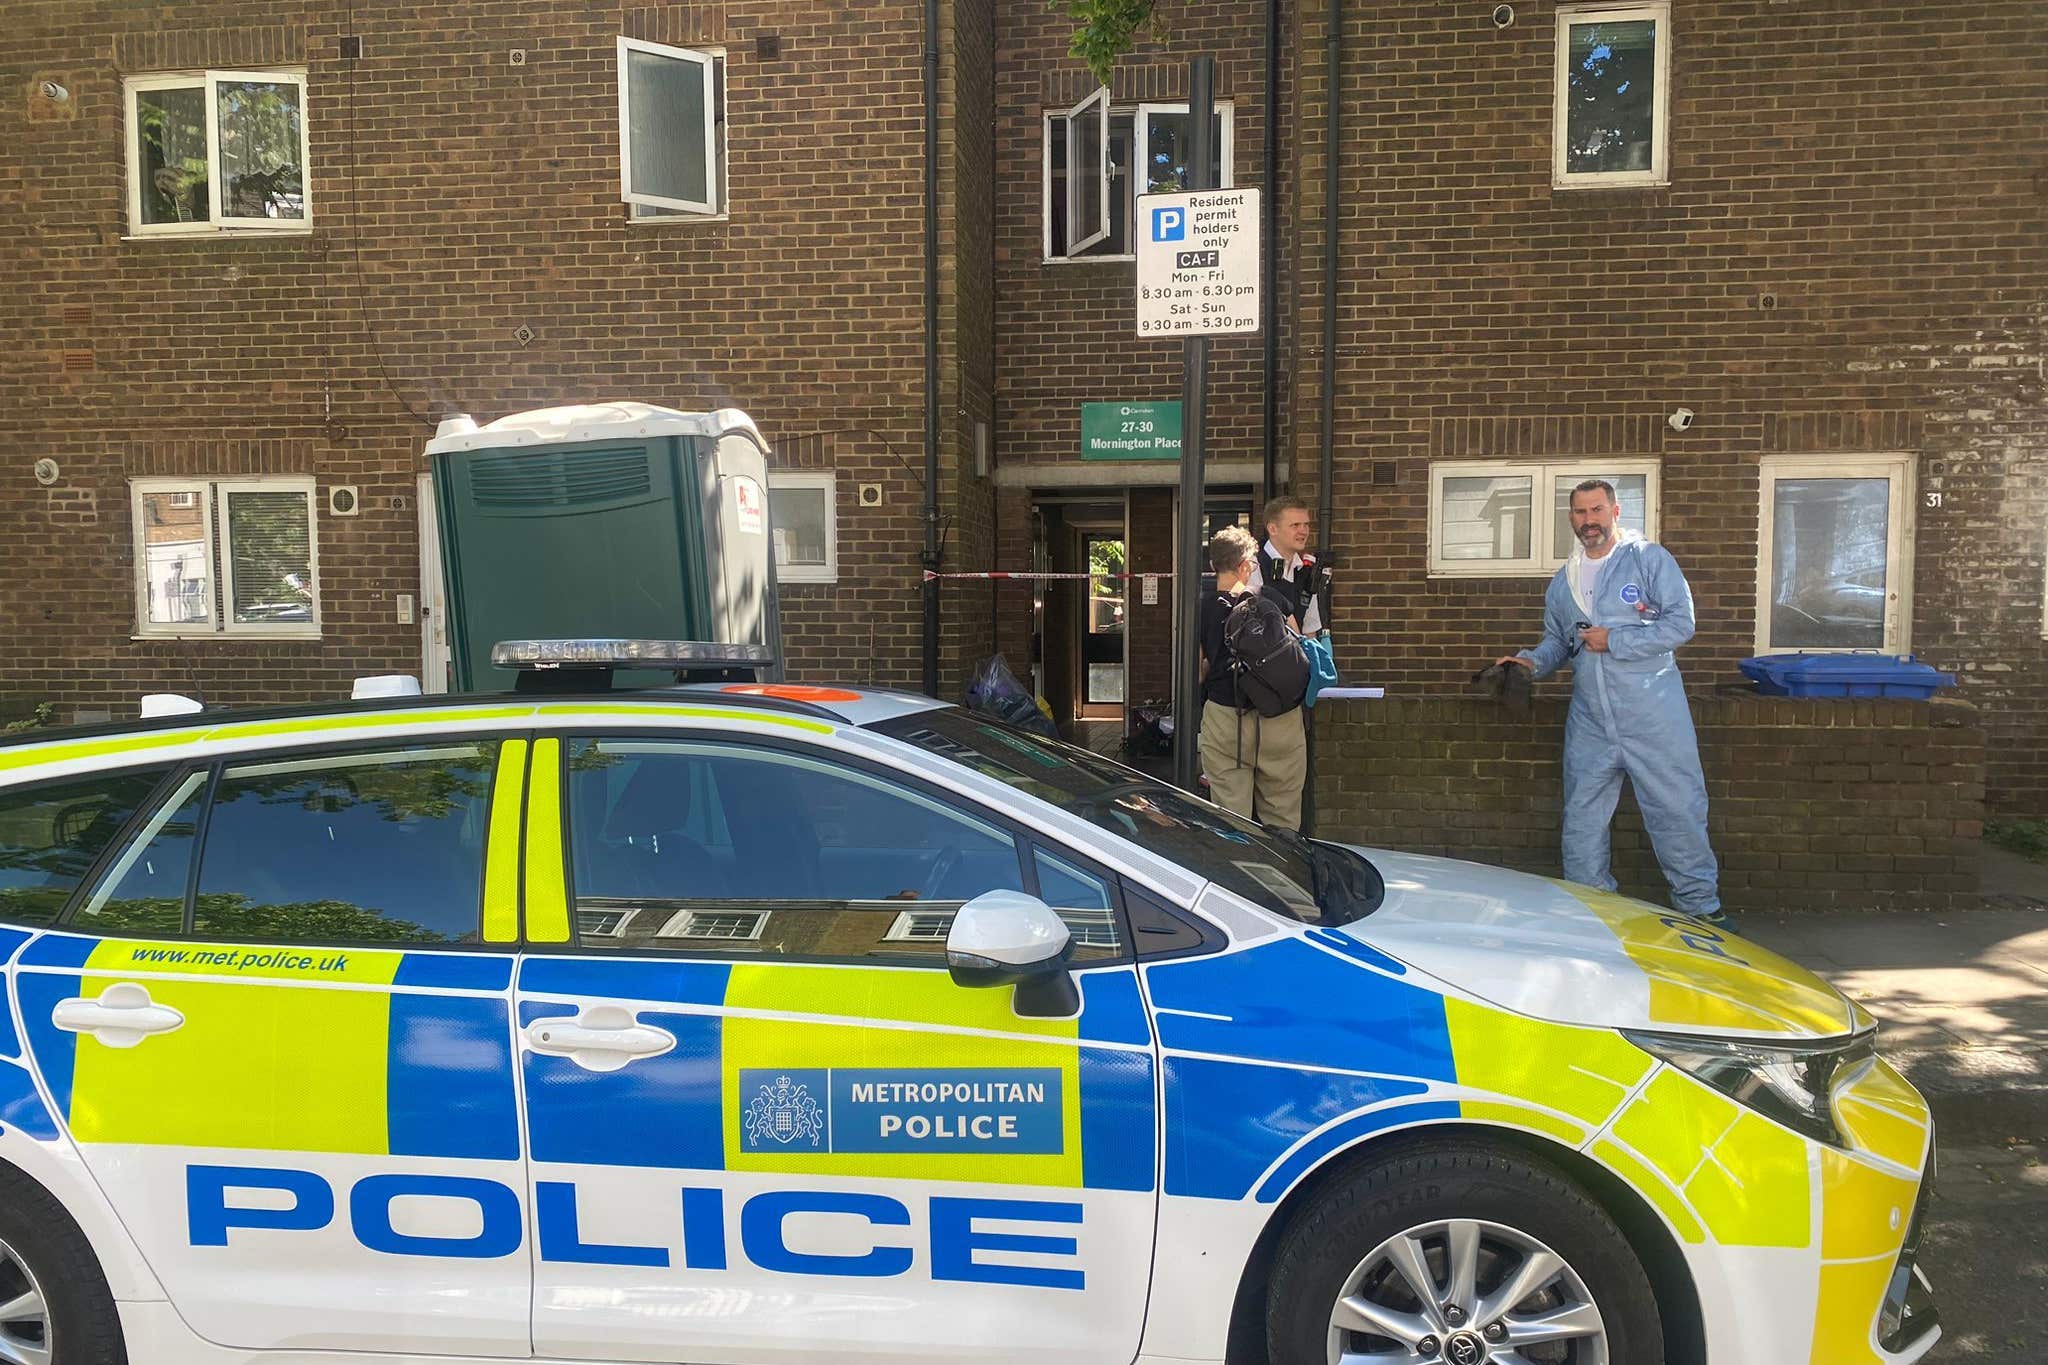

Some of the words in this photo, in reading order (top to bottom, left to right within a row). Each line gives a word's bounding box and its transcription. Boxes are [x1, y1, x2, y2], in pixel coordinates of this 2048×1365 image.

[1190, 195, 1244, 208] Resident
[1196, 209, 1237, 222] permit
[1160, 211, 1180, 239] P
[1193, 222, 1240, 234] holders
[1203, 236, 1230, 248] only
[1180, 252, 1216, 267] CA-F
[1172, 272, 1198, 283] Mon
[1208, 270, 1225, 281] Fri
[1142, 288, 1172, 300] 8.30
[1175, 290, 1193, 298] am
[1202, 285, 1233, 296] 6.30
[1235, 286, 1254, 296] pm
[1170, 304, 1192, 315] Sat
[1201, 303, 1226, 313] Sun
[1142, 319, 1172, 331] 9.30
[1174, 321, 1192, 329] am
[1202, 317, 1232, 328] 5.30
[1235, 318, 1254, 328] pm
[1120, 421, 1154, 433] 27-30
[1090, 438, 1151, 451] Mornington
[1926, 492, 1942, 507] 31
[131, 948, 349, 972] www.met.police.uk
[851, 1082, 1044, 1104] METROPOLITAN
[879, 1114, 1019, 1139] POLICE
[186, 1163, 1086, 1291] POLICE
